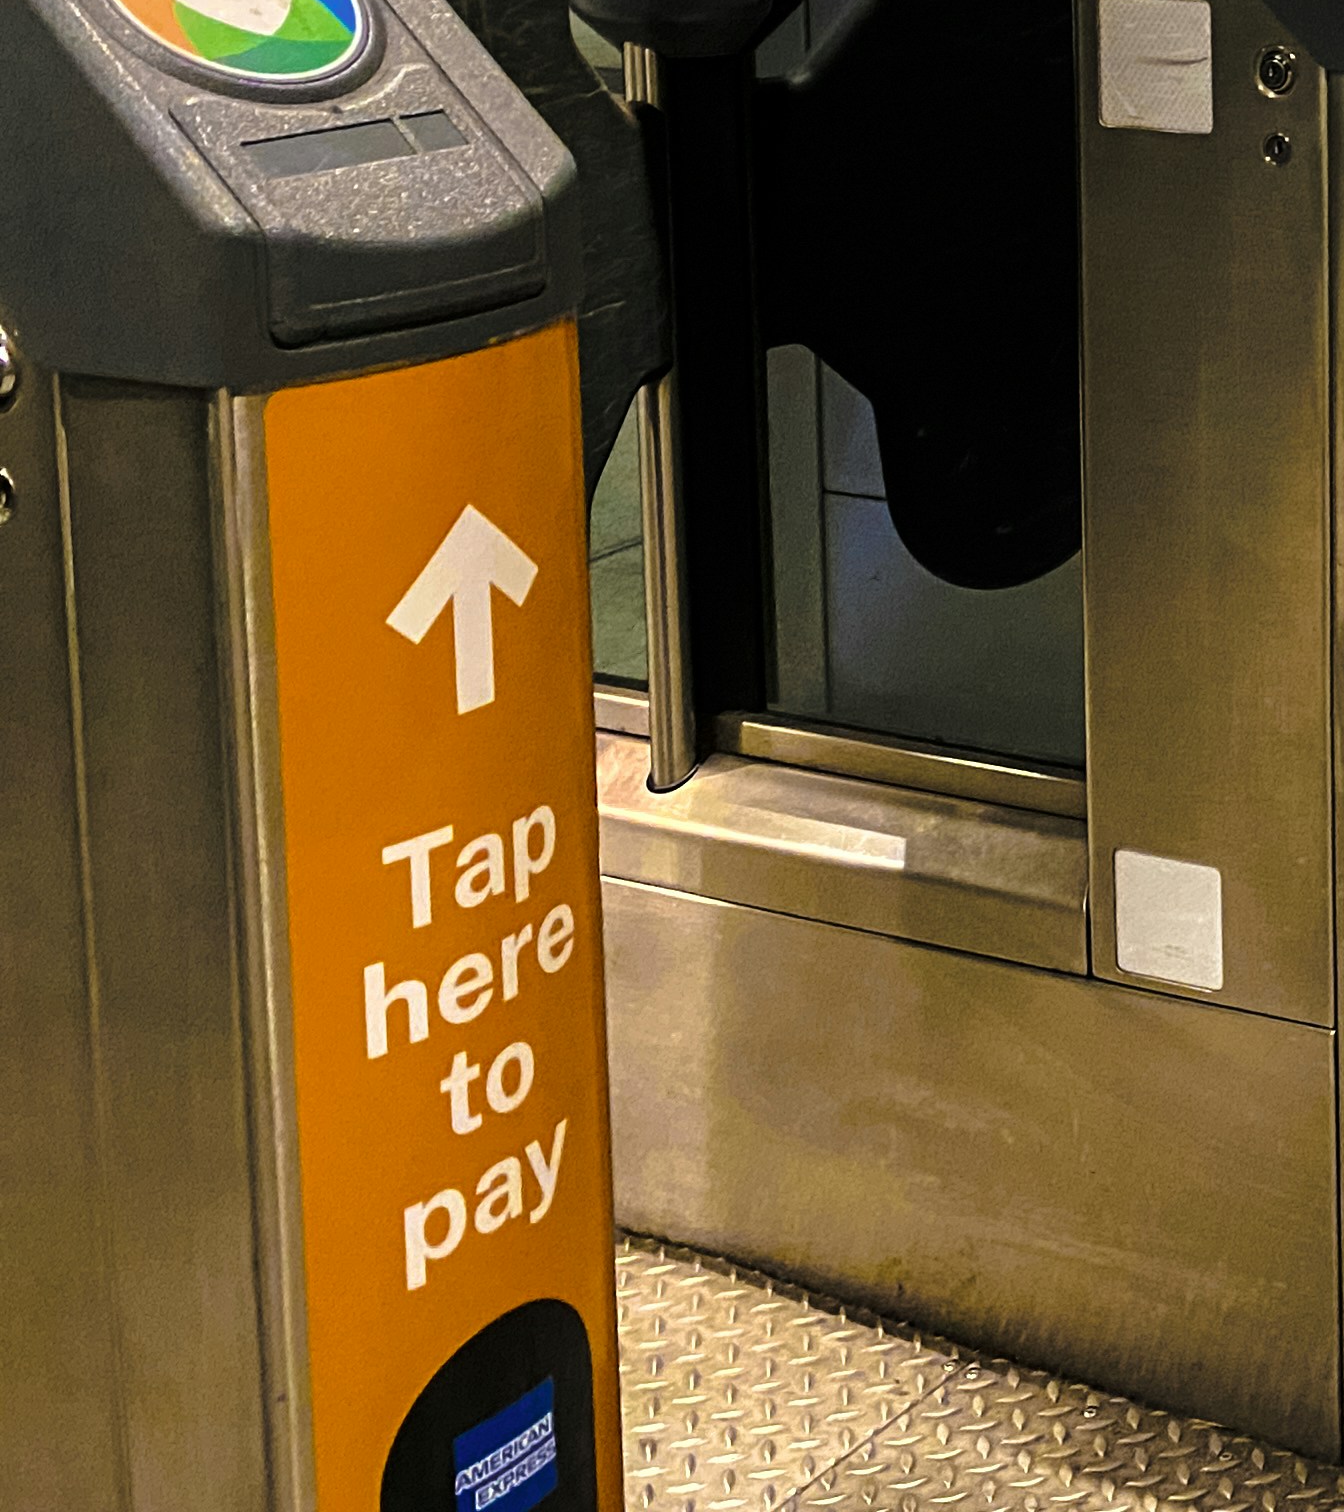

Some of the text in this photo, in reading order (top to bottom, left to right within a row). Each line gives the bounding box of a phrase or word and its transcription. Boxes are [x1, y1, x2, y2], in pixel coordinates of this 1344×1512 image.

[382, 804, 556, 928] Tap
[363, 903, 575, 1060] here
[440, 1041, 535, 1136] to
[404, 1118, 568, 1291] pay
[456, 1414, 552, 1493] AMERICAN
[476, 1441, 556, 1509] EXPRESS
